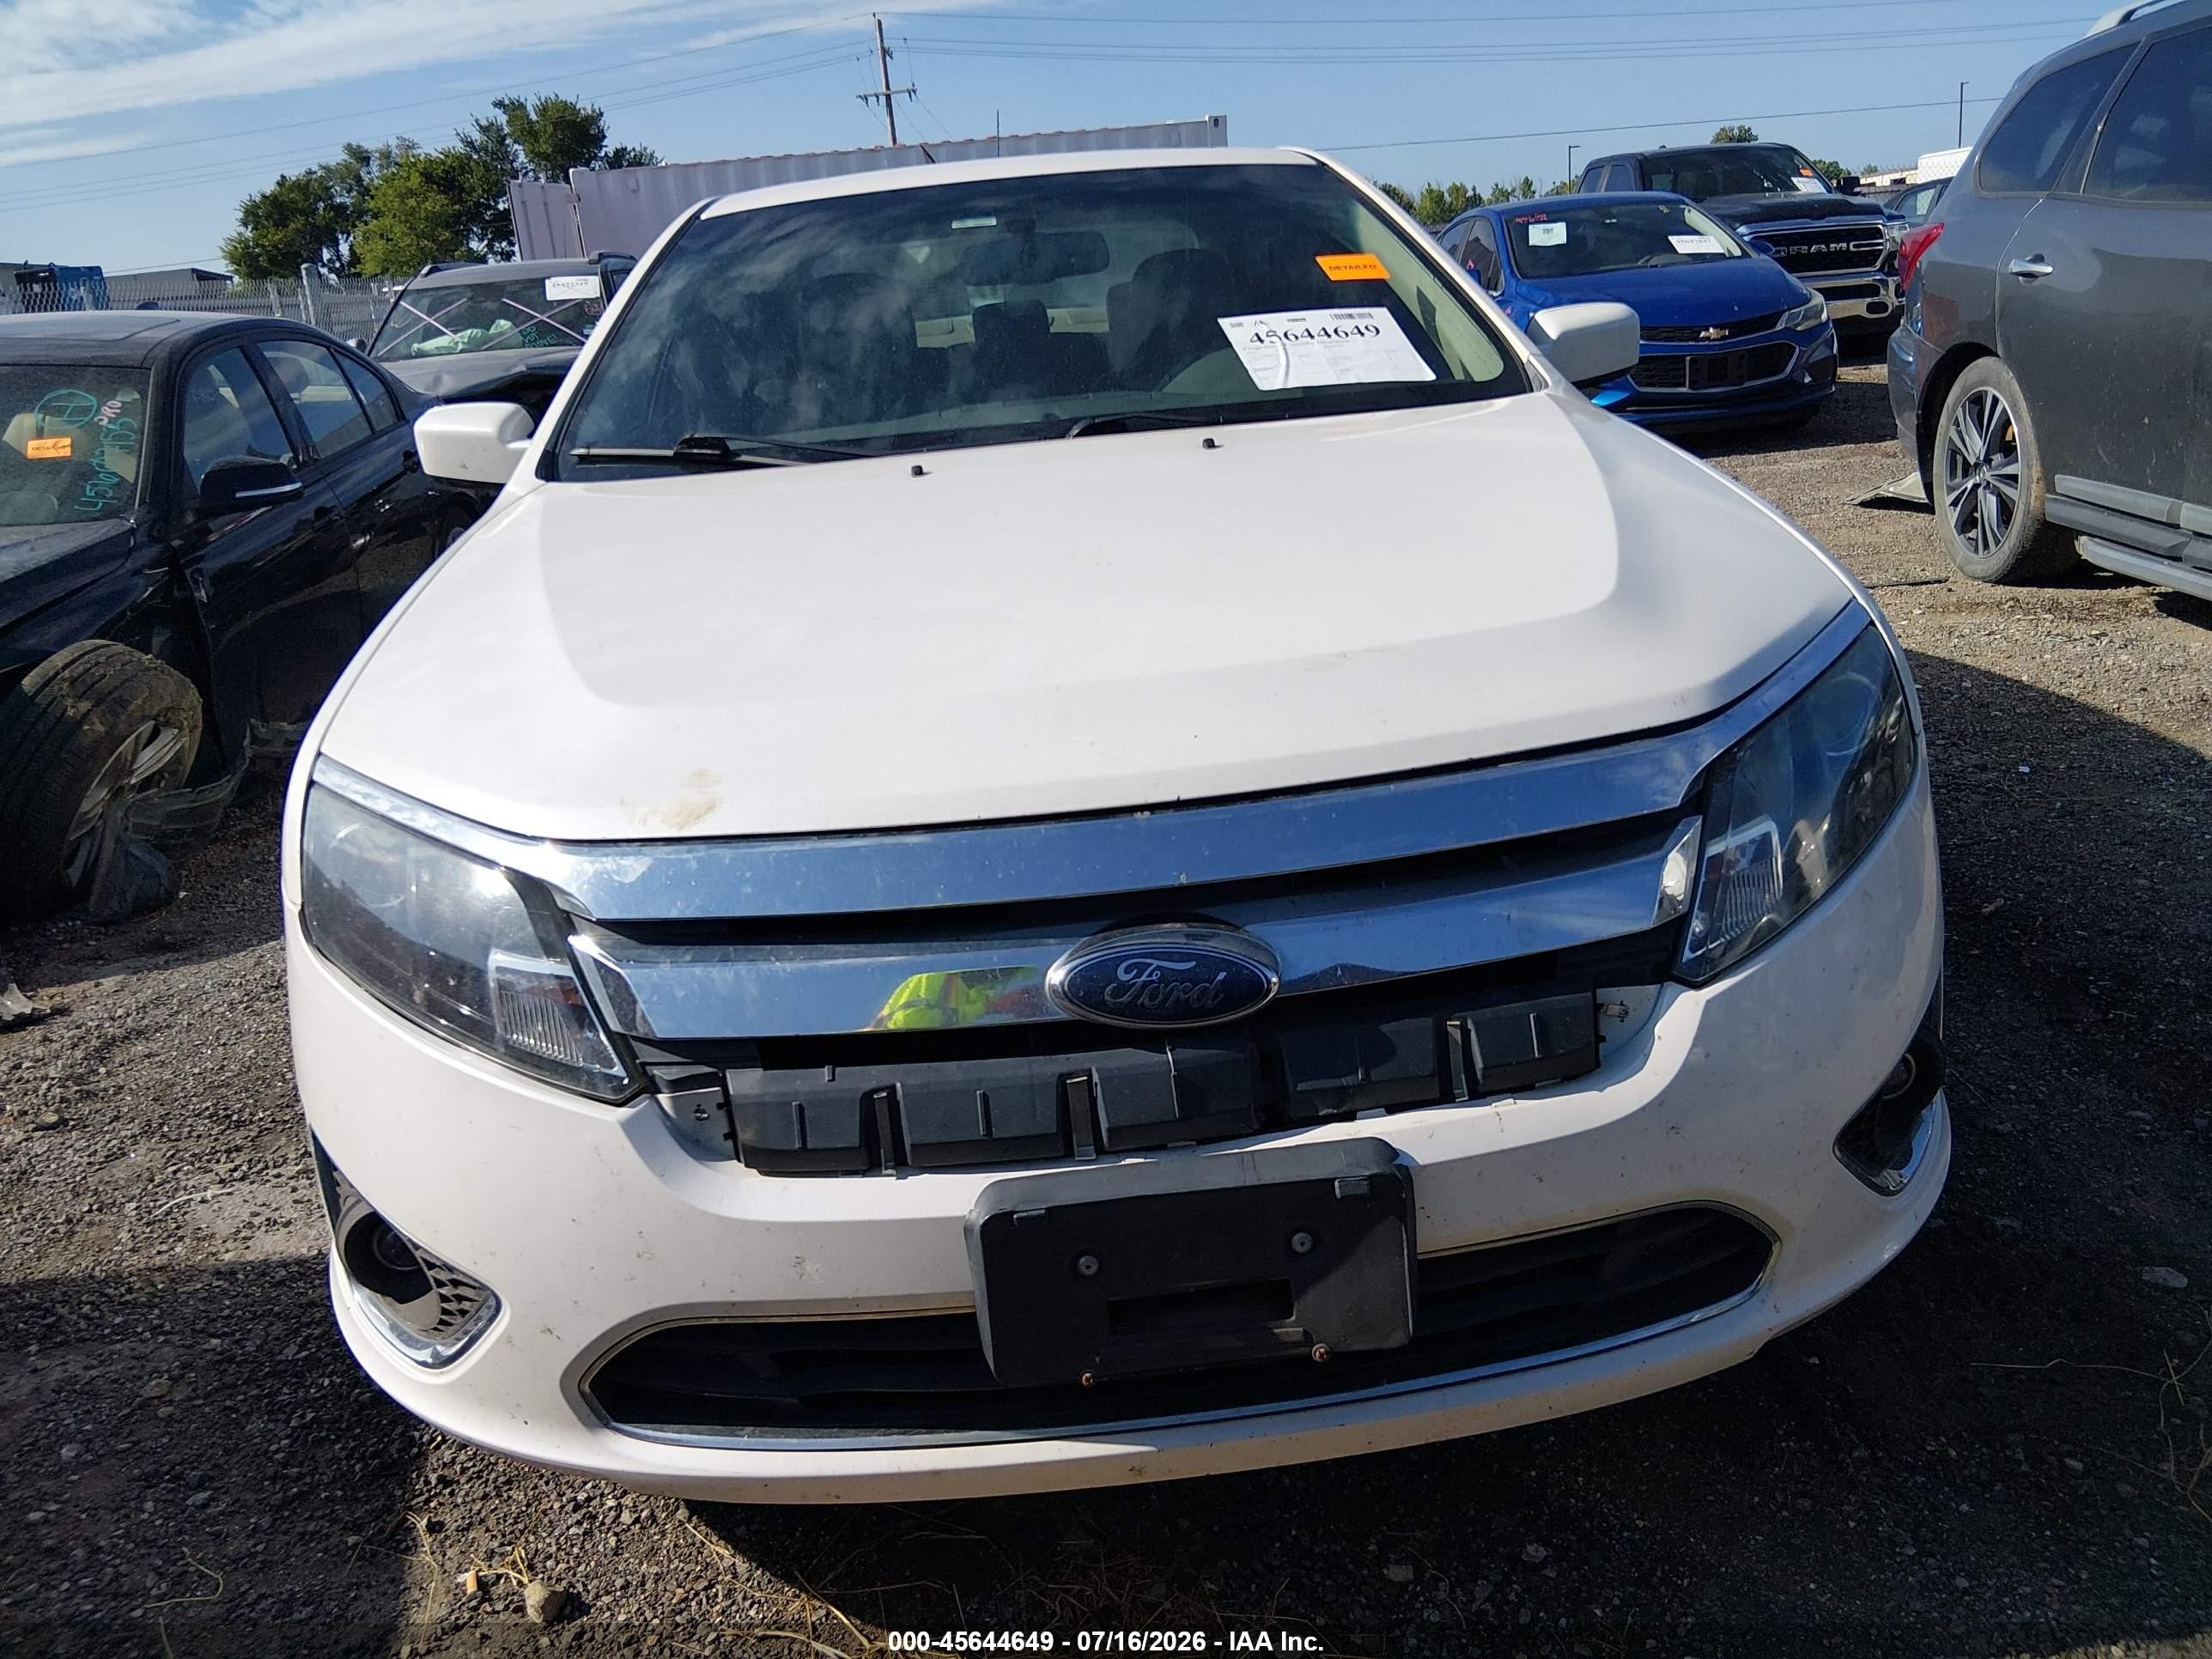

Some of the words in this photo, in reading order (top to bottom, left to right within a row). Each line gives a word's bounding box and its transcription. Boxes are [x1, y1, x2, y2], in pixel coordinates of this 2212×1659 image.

[1790, 242, 1848, 255] RAM
[1328, 264, 1378, 273] DETAILED
[1249, 324, 1381, 345] 45644649
[1103, 957, 1228, 1009] Ford
